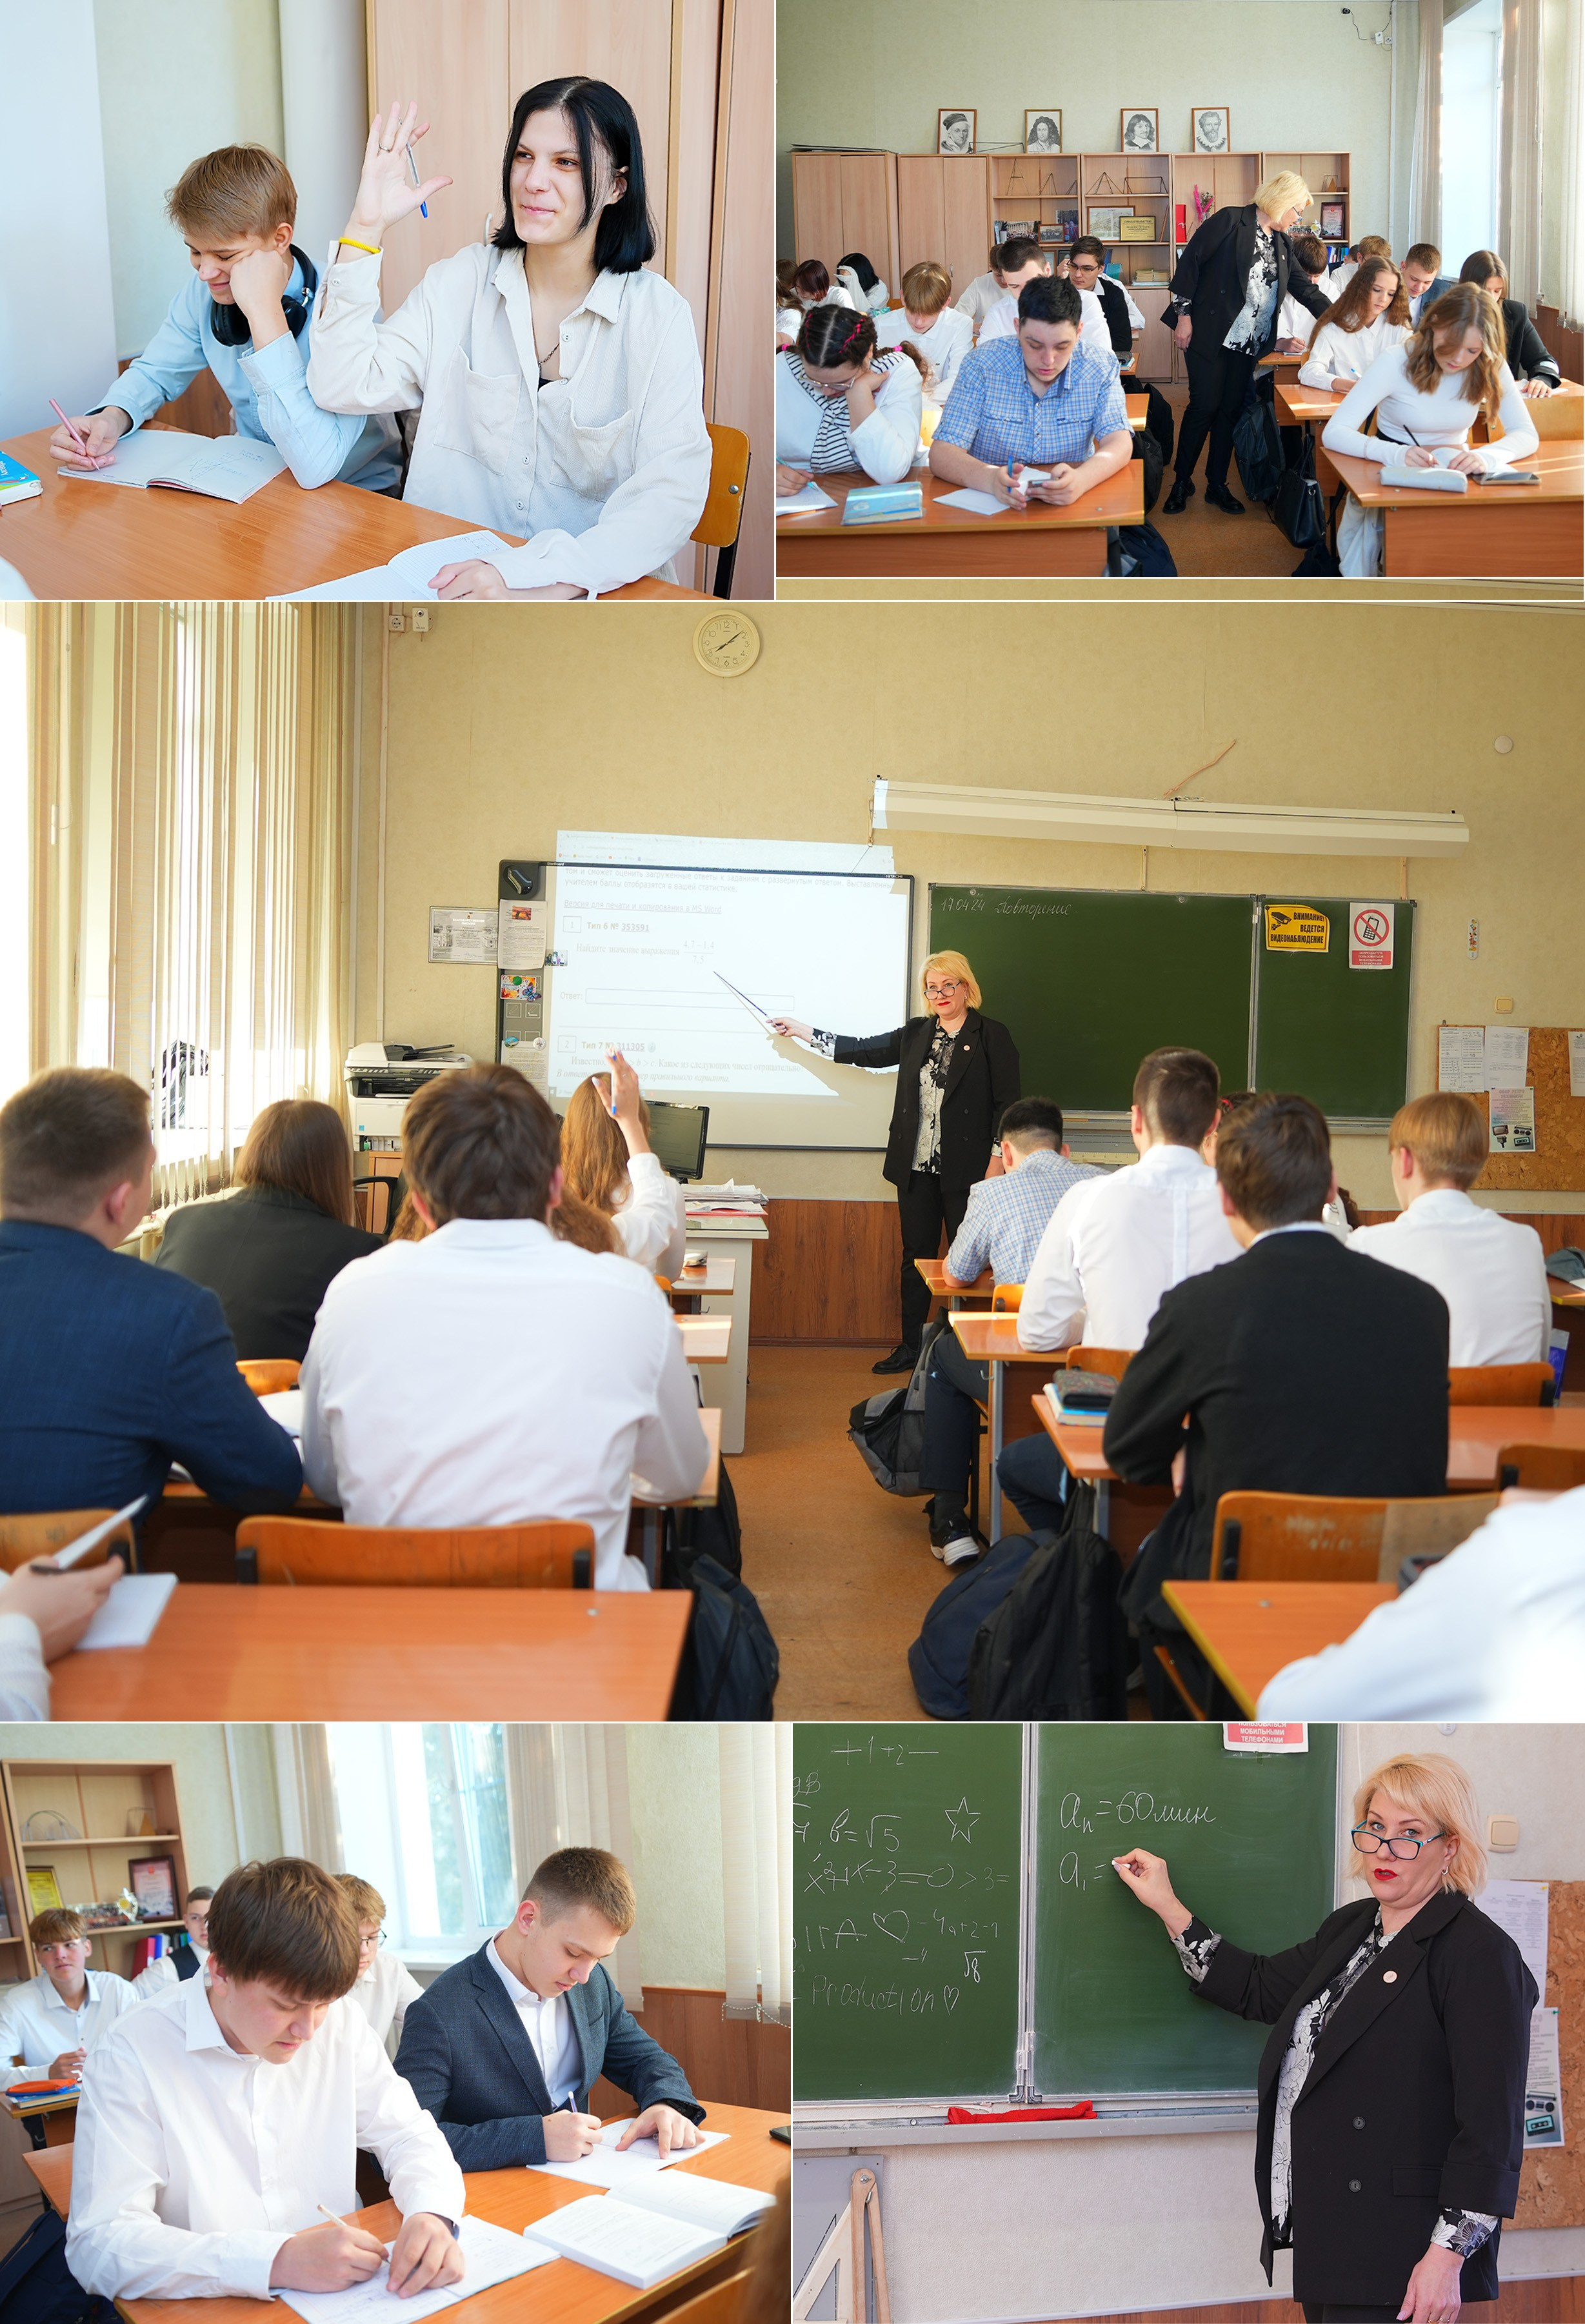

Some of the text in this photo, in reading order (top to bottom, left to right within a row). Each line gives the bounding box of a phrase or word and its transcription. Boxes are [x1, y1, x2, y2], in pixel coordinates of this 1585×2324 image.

[565, 879, 597, 888] учителем
[624, 881, 666, 890] отобразятся
[646, 872, 692, 880] загруженные
[727, 874, 759, 883] заданиям
[768, 878, 813, 887] развернутым
[564, 900, 589, 909] Версия
[704, 905, 722, 914] Word
[1293, 912, 1325, 921] ВНИМАНИЕ!
[621, 923, 650, 932] 353591
[1300, 925, 1325, 934] ВЕДЕТСЯ
[1270, 934, 1324, 945] ВИДЕОНАБЛЮДЕНИЕ
[577, 943, 680, 956] Найдите значение выражения
[560, 992, 583, 1000] Ответ:
[565, 1040, 569, 1048] 2
[617, 1043, 645, 1052] 311305
[571, 1056, 606, 1066] Известно,
[658, 1059, 679, 1068] Какое
[690, 1063, 730, 1071] следующих
[556, 1069, 562, 1077] В
[650, 1073, 693, 1082] правильного
[694, 1074, 730, 1083] варианта.
[812, 1974, 935, 2016] Production
